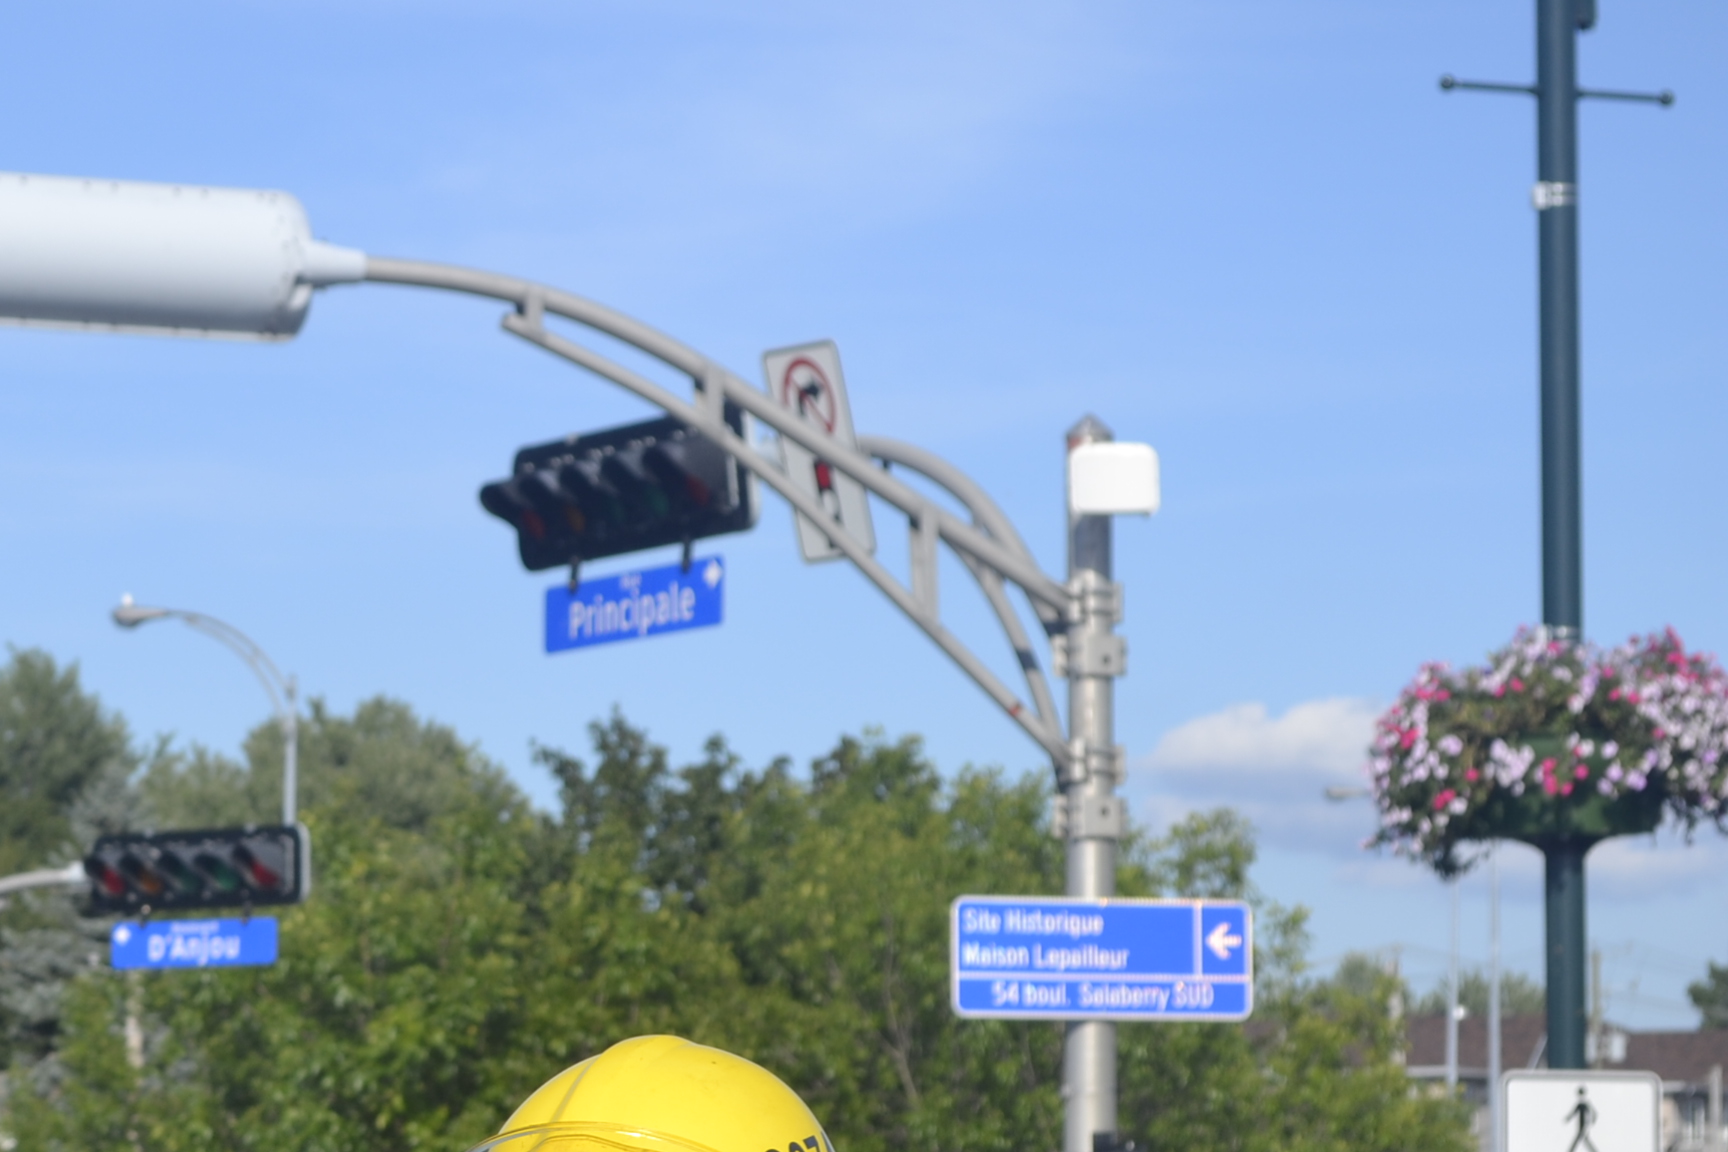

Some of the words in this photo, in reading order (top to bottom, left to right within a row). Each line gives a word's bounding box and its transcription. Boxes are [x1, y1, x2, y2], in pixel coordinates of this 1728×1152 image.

[568, 581, 696, 640] Principale
[962, 907, 1001, 934] Site
[1004, 908, 1104, 939] Historique
[962, 941, 1029, 968] Maison
[1032, 942, 1130, 972] Lepailleur
[992, 980, 1020, 1006] 54
[1077, 982, 1170, 1011] Salaberry
[1175, 982, 1215, 1009] SUD
